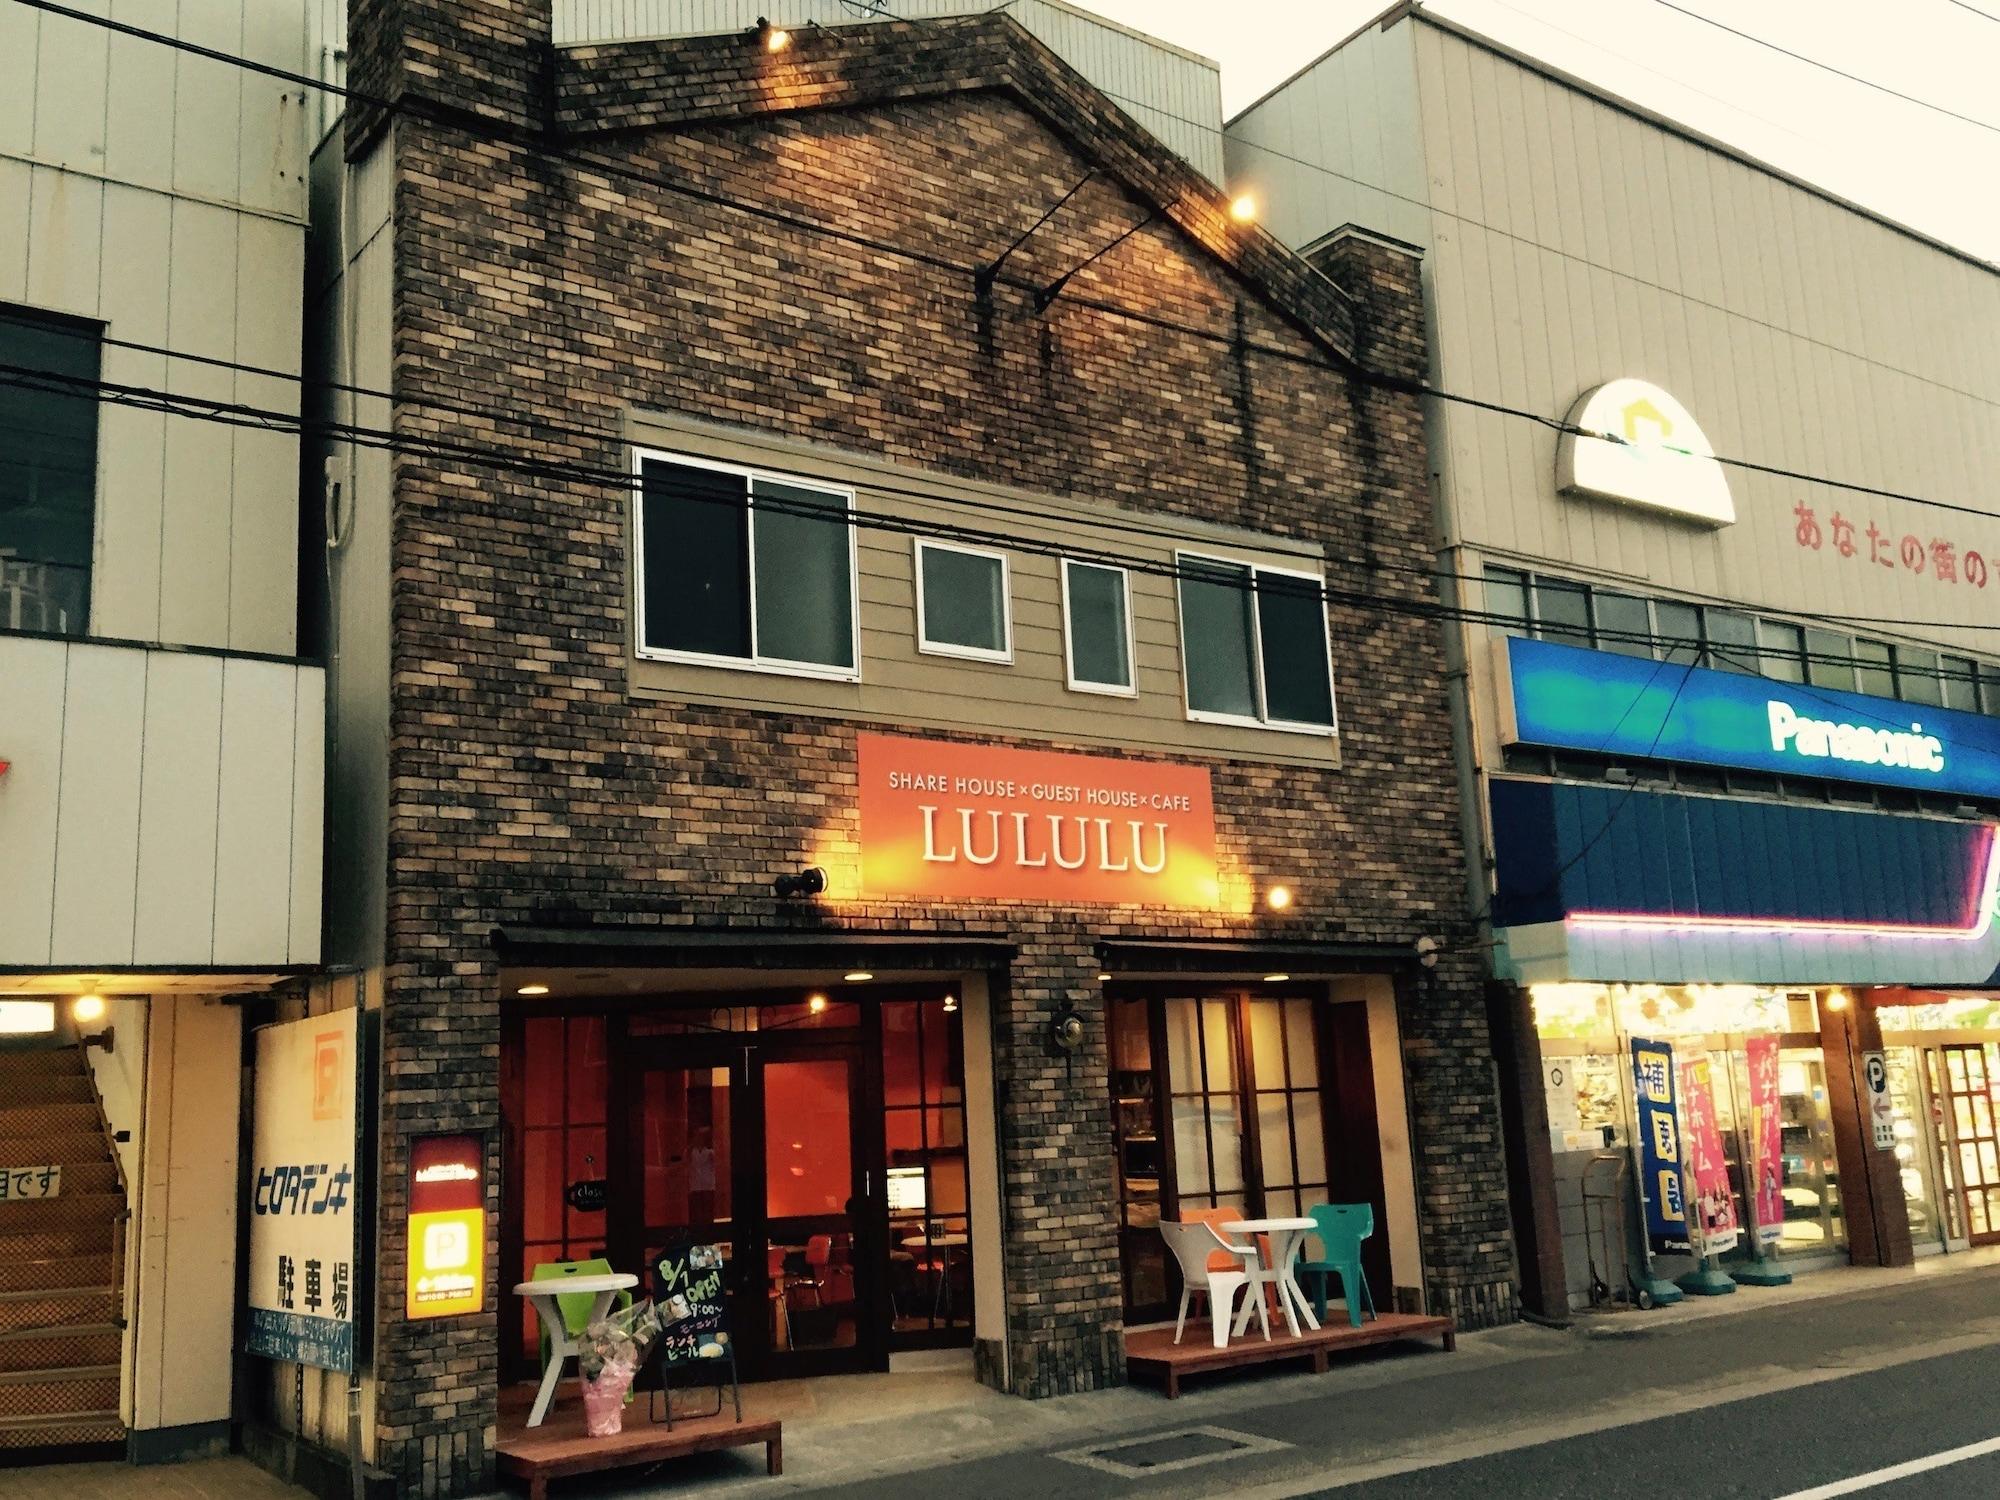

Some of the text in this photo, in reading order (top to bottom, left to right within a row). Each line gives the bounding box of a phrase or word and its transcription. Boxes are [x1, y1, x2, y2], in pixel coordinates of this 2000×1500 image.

[1794, 500, 2000, 589] あなたの街の
[1767, 700, 1944, 773] Panasonic
[889, 771, 948, 793] SHARE
[918, 805, 1168, 874] LULULU
[1869, 1061, 1884, 1091] P
[254, 1163, 351, 1216] ヒロタデンキ
[277, 1255, 350, 1320] 駐車場
[685, 1270, 721, 1303] OPEN
[665, 1334, 697, 1349] ランチ
[667, 1346, 699, 1361] ビール
